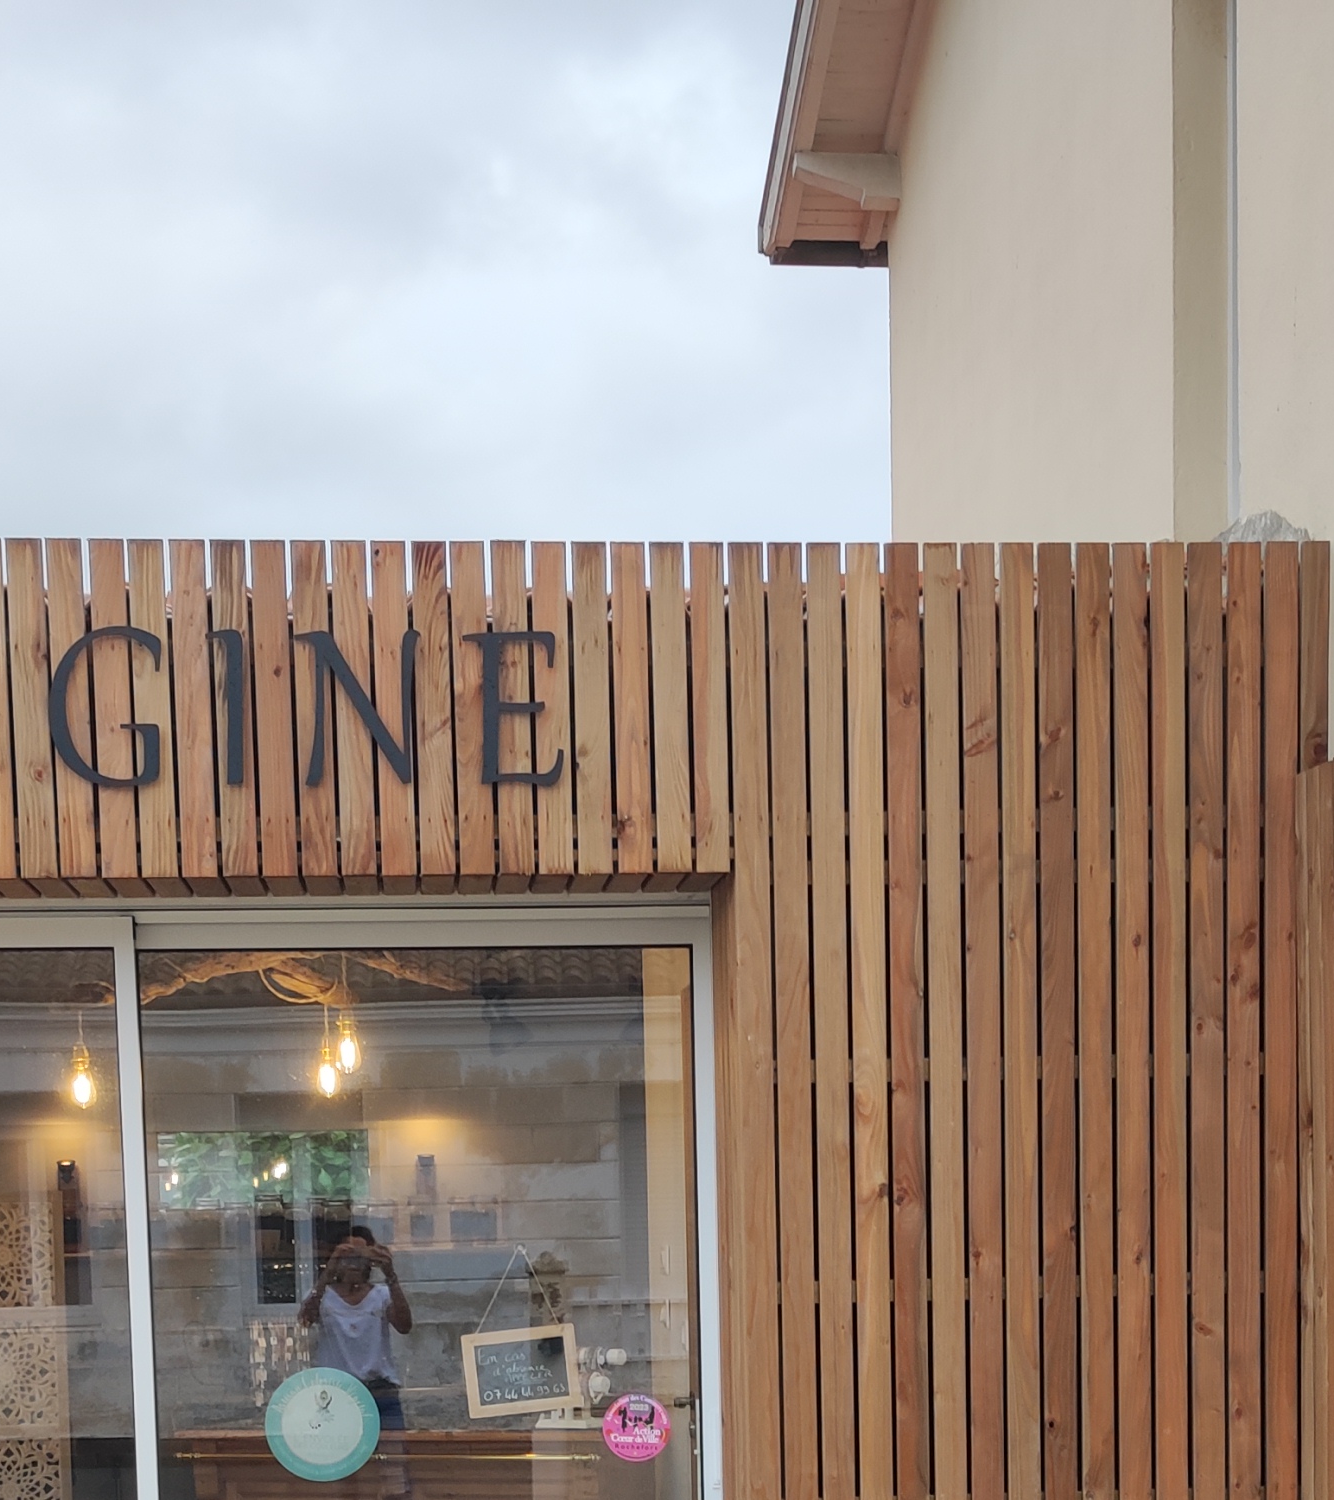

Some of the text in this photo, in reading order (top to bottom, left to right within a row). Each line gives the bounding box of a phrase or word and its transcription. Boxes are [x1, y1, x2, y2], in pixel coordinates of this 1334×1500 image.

[478, 1348, 526, 1365] En cas
[484, 1389, 501, 1401] 07
[505, 1388, 518, 1399] 44
[521, 1386, 534, 1397] 44
[633, 1426, 661, 1436] Action
[615, 1443, 658, 1451] Rochefort
